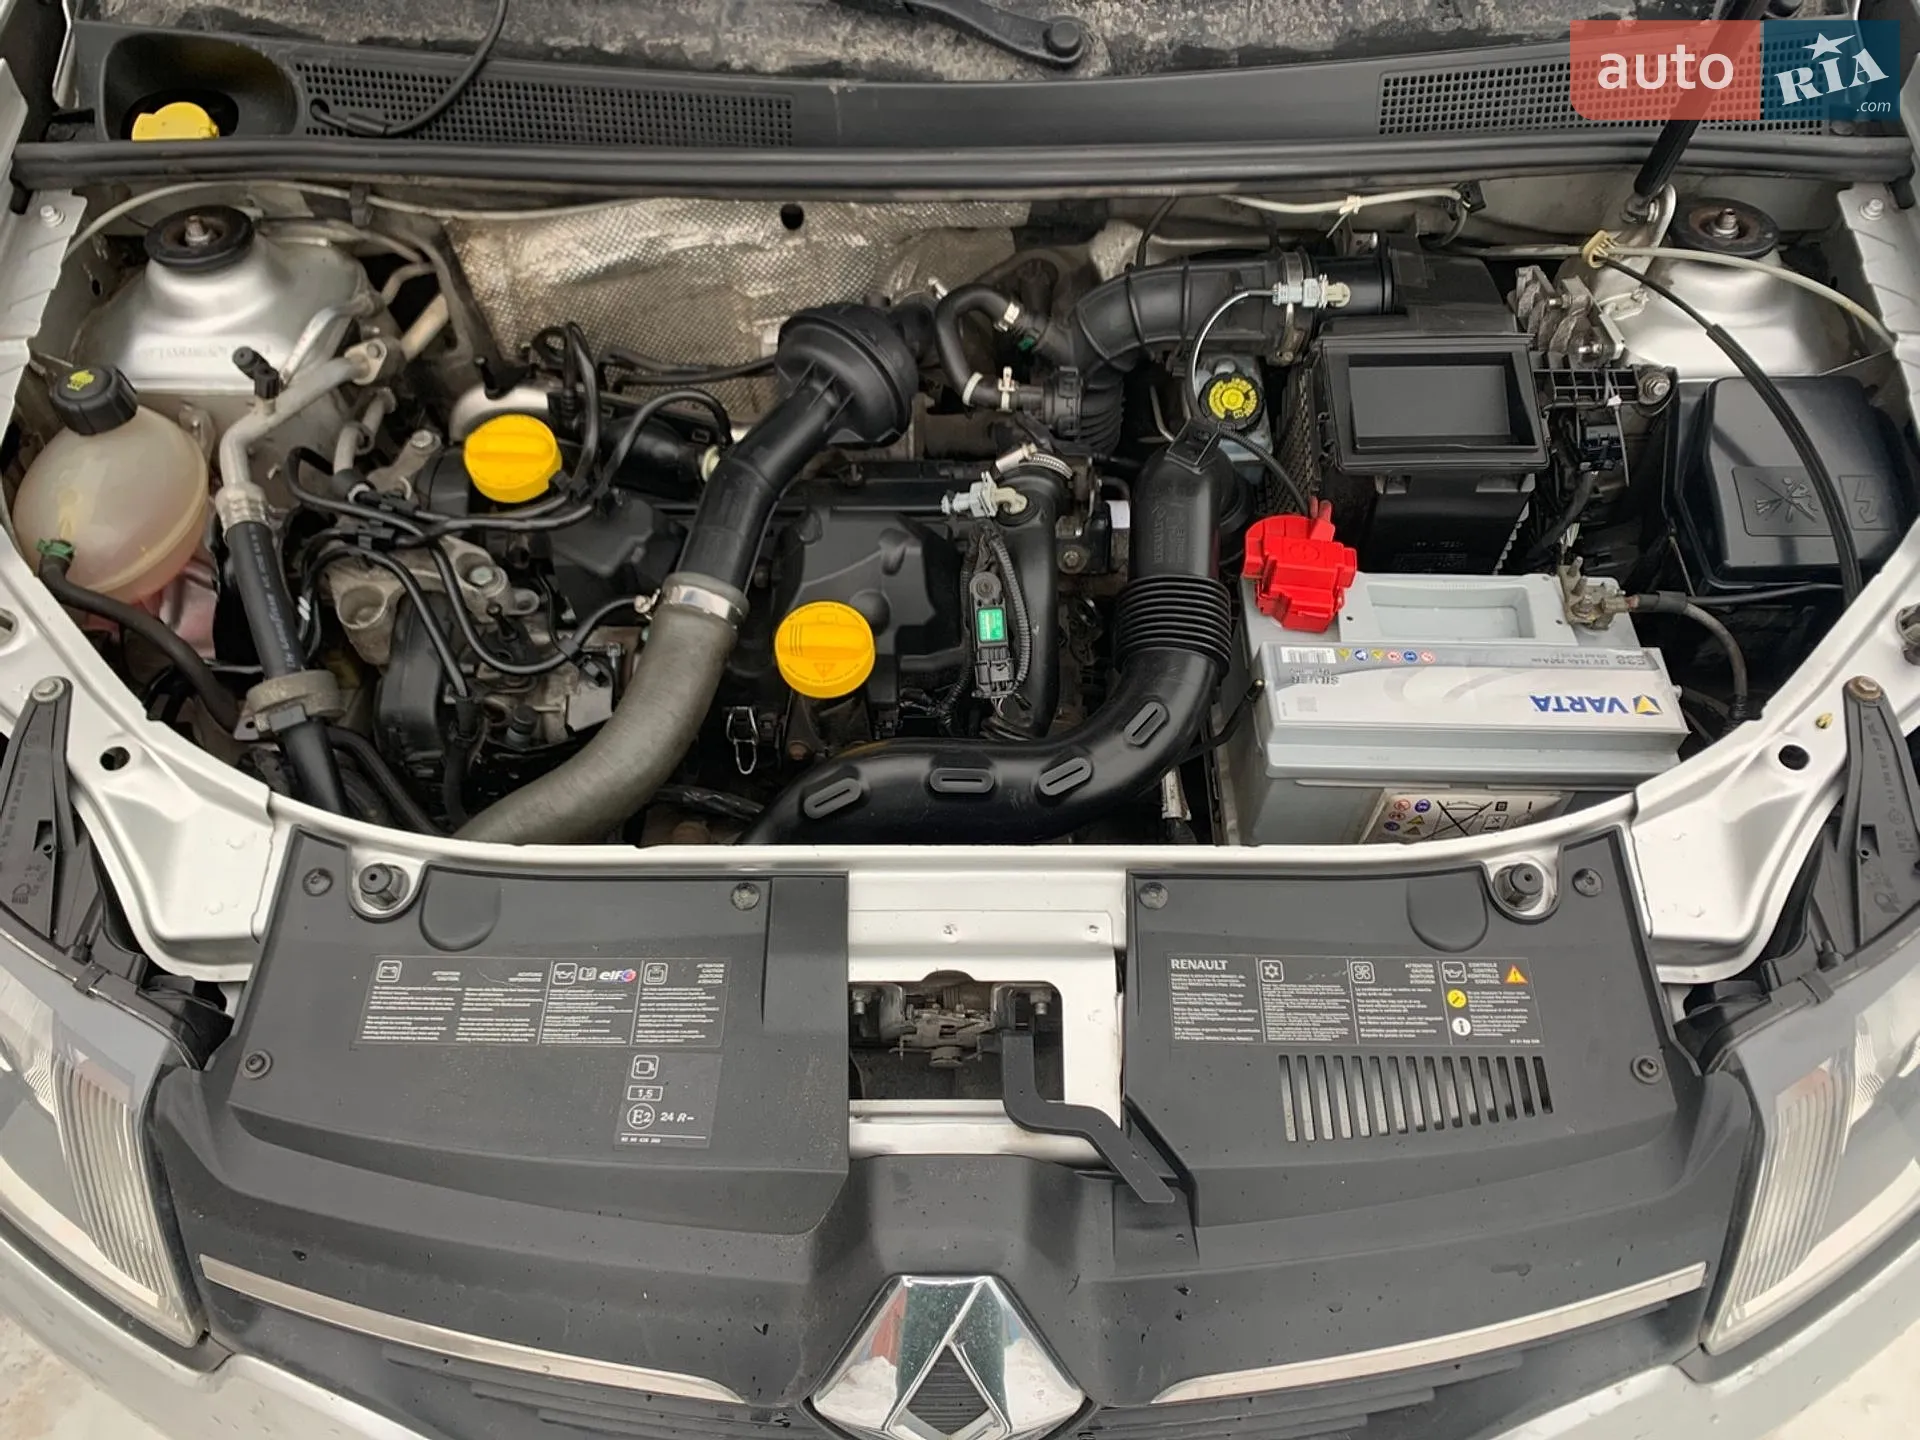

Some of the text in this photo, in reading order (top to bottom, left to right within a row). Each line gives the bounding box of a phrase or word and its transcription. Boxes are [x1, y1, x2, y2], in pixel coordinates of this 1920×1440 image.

[1529, 694, 1630, 715] VARTA
[1170, 958, 1229, 971] RENAULT
[631, 1108, 653, 1125] E2
[659, 1110, 675, 1123] 24
